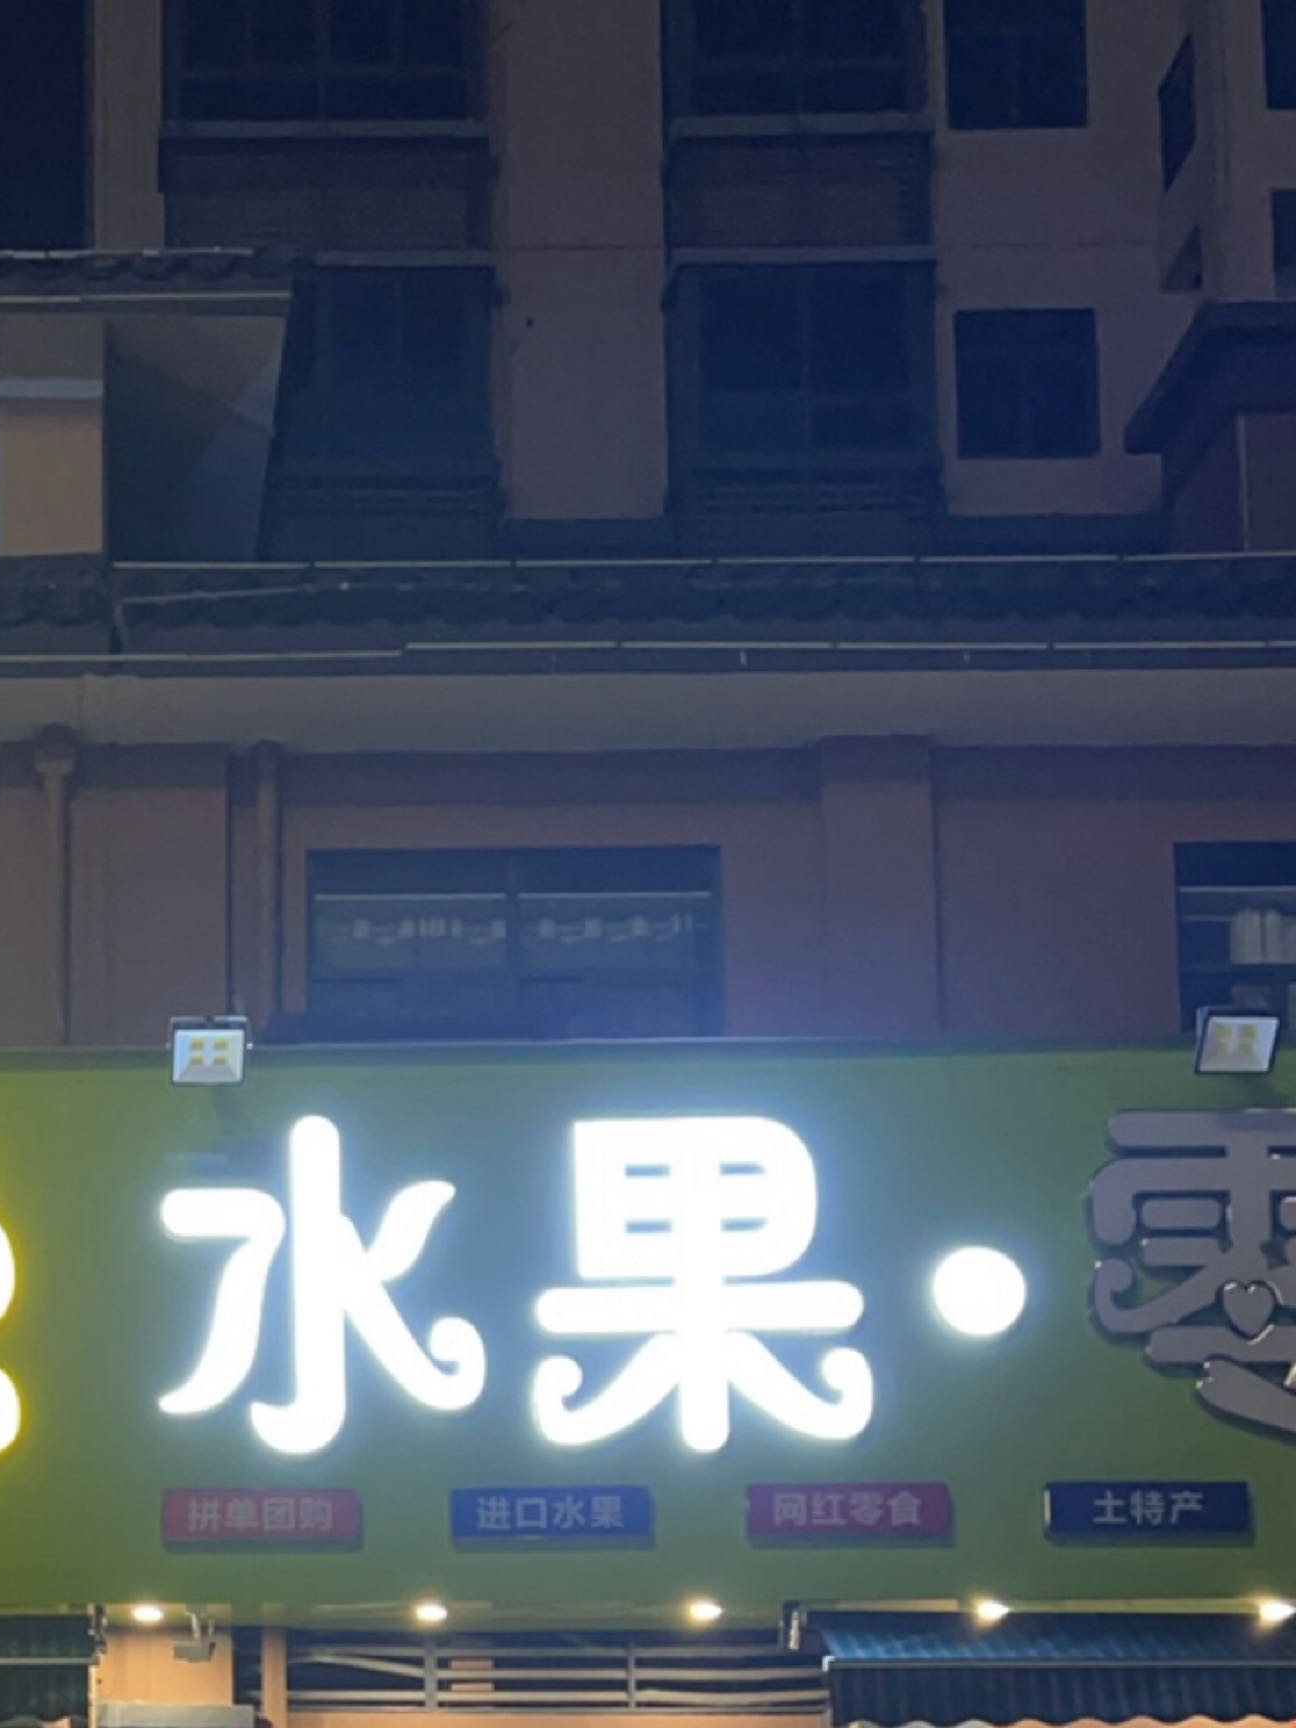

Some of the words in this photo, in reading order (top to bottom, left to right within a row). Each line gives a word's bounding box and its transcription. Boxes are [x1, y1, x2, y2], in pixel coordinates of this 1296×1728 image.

[187, 1497, 335, 1533] 拼单团购
[476, 1495, 626, 1531] 进口水果
[771, 1491, 923, 1527] 网红零食
[1092, 1490, 1205, 1525] 土特产
